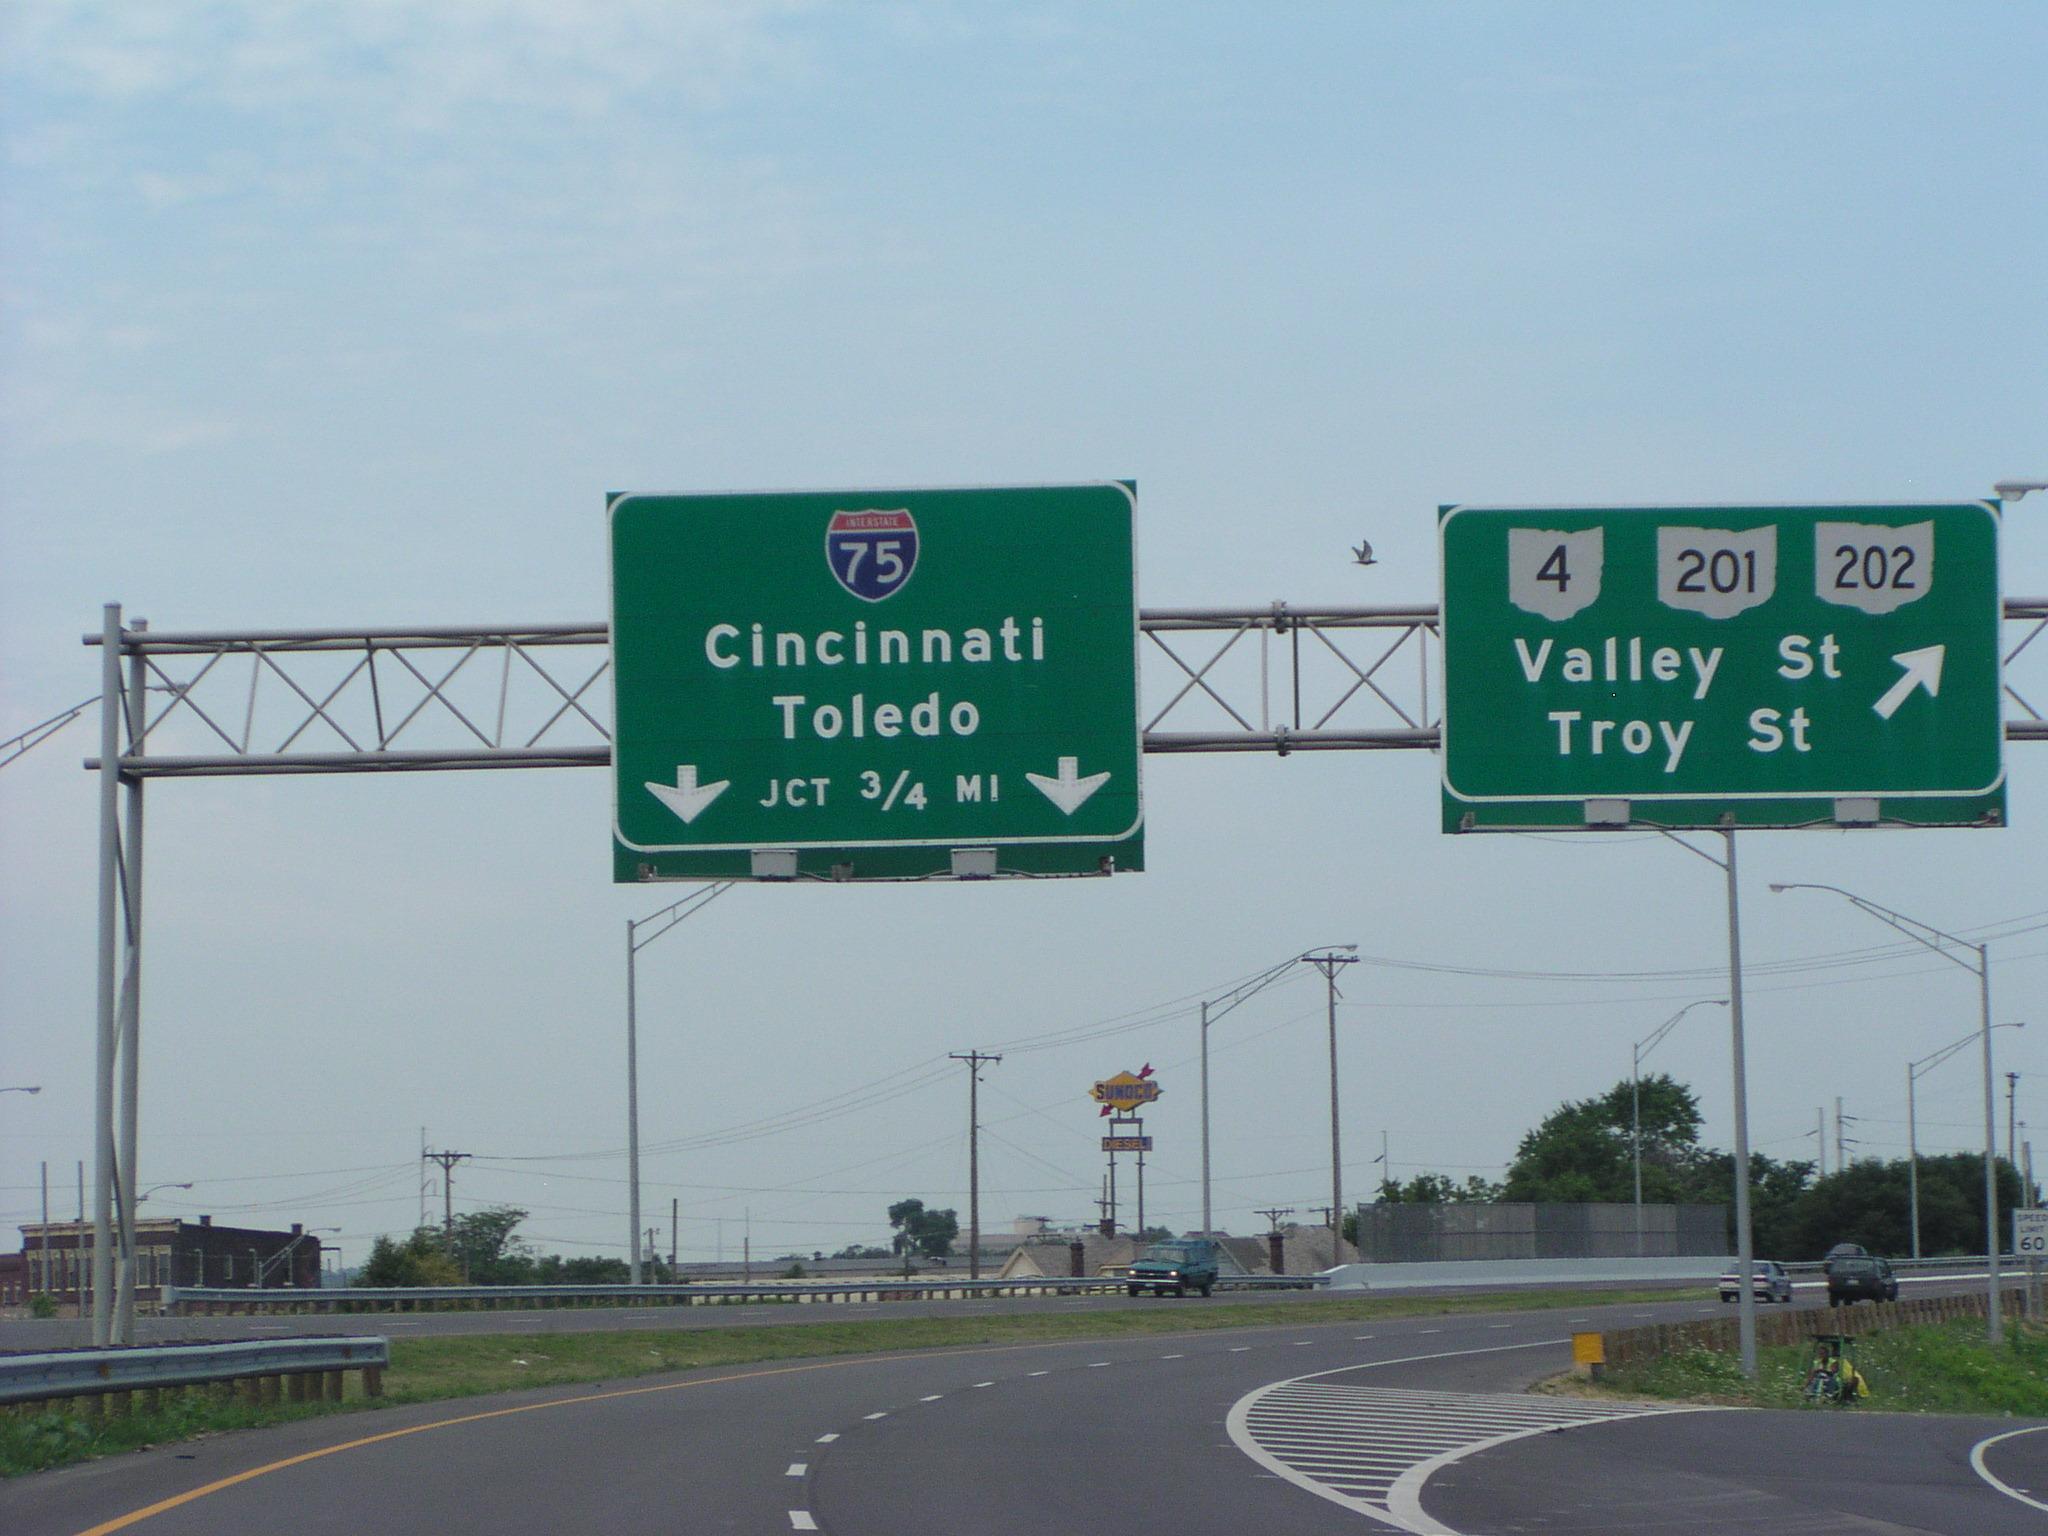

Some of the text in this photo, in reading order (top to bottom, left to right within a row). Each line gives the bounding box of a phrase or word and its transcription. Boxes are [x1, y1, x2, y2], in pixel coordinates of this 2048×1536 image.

[847, 516, 898, 527] INTERSTATE
[839, 540, 904, 584] 75
[1536, 544, 1571, 593] 4
[1676, 548, 1756, 594] 201
[1835, 544, 1915, 590] 202
[705, 616, 1044, 669] Cincinnati
[1514, 633, 1842, 700] Valley St
[772, 691, 980, 739] Toledo
[1548, 706, 1812, 773] Troy St
[759, 769, 999, 811] JCT 3/4 MI
[1096, 1083, 1157, 1100] SUNOCO
[1103, 1139, 1148, 1150] DIESEL
[2018, 1213, 2048, 1222] SPEED
[2021, 1225, 2044, 1233] LIMIT
[2021, 1236, 2045, 1250] 60
